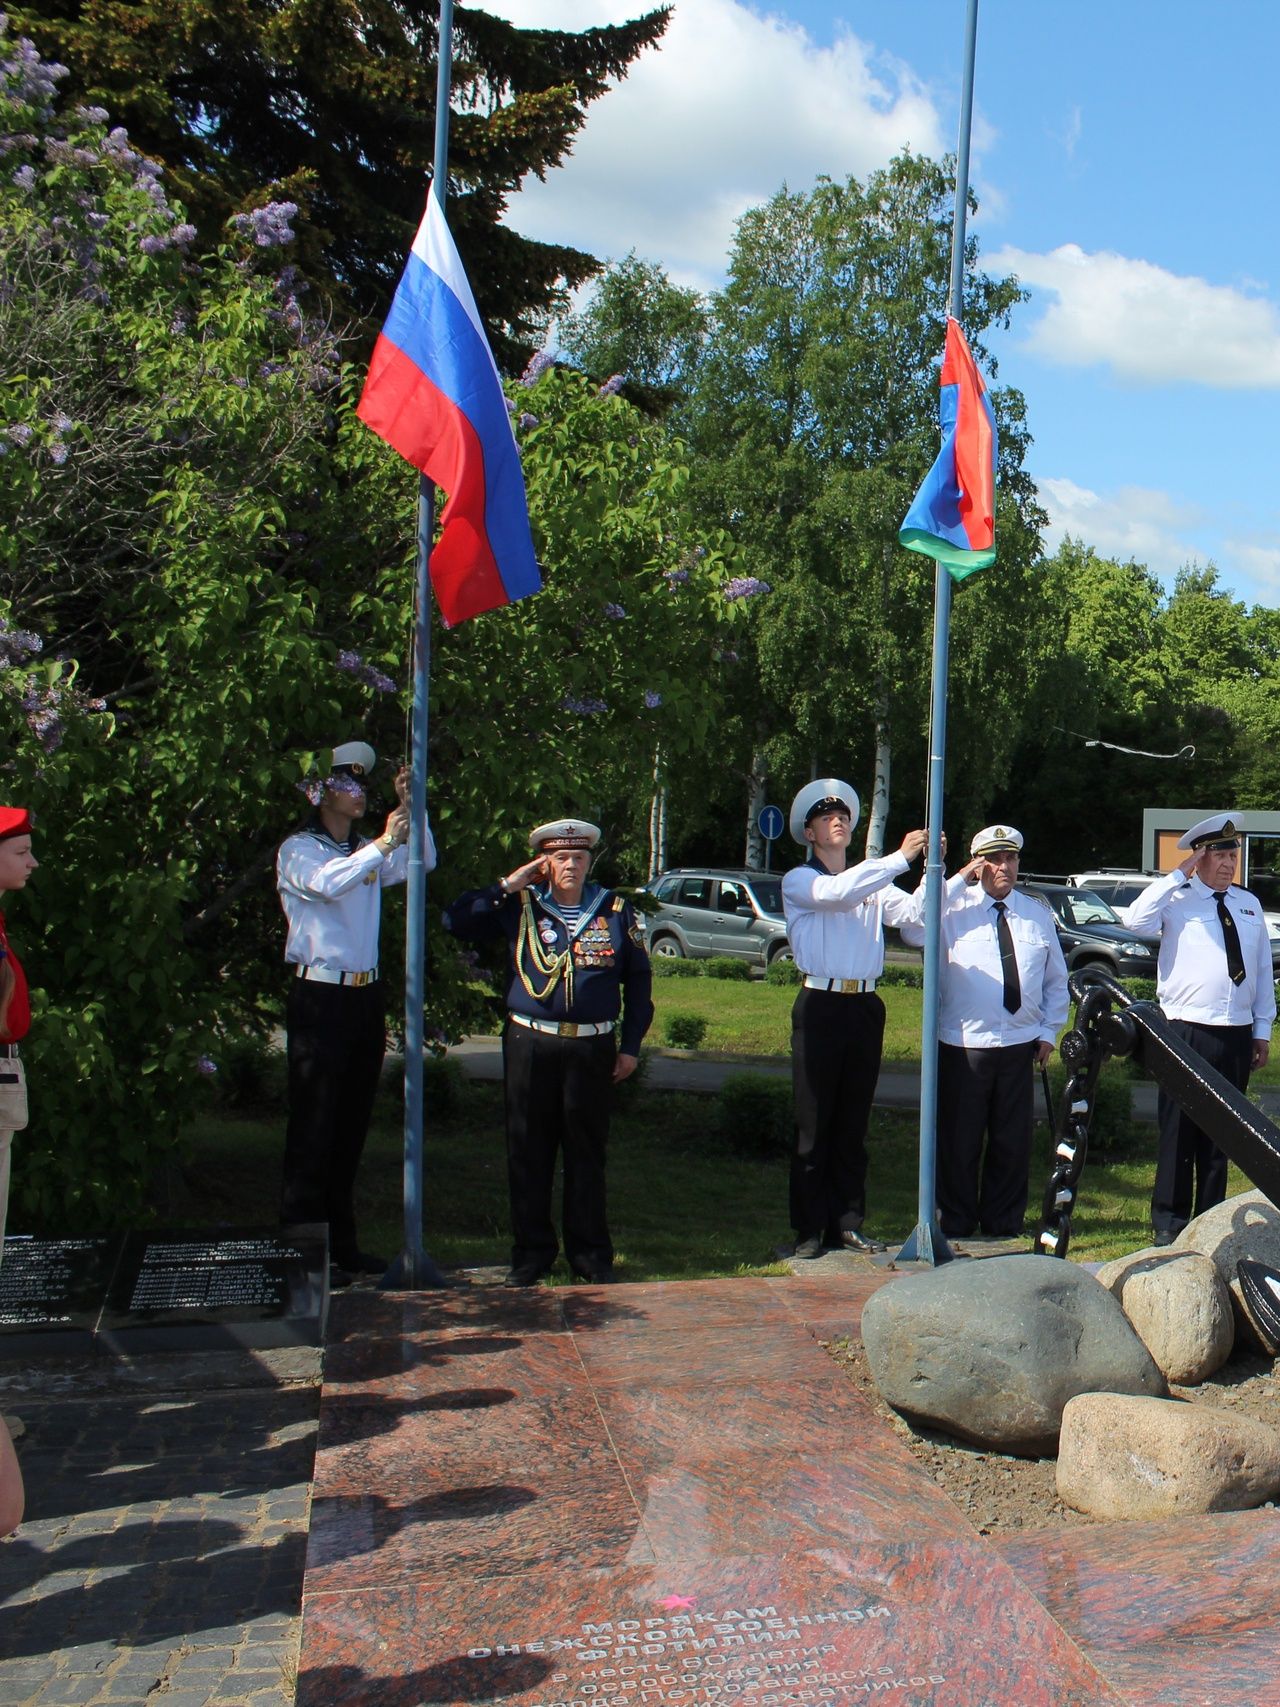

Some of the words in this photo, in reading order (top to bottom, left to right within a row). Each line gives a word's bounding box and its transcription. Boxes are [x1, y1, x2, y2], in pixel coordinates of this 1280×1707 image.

[466, 1624, 696, 1659] ОНЕЖСКОЙ
[713, 1604, 892, 1635] ВОЕННОЙ
[580, 1605, 777, 1635] МОРЯКАМ
[575, 1628, 801, 1662] ФЛОТИЛИИ
[551, 1672, 569, 1683] в
[581, 1663, 671, 1680] честь
[580, 1659, 820, 1694] освобождения
[640, 1664, 894, 1702] Петрозаводска
[742, 1673, 946, 1706] захватчиков
